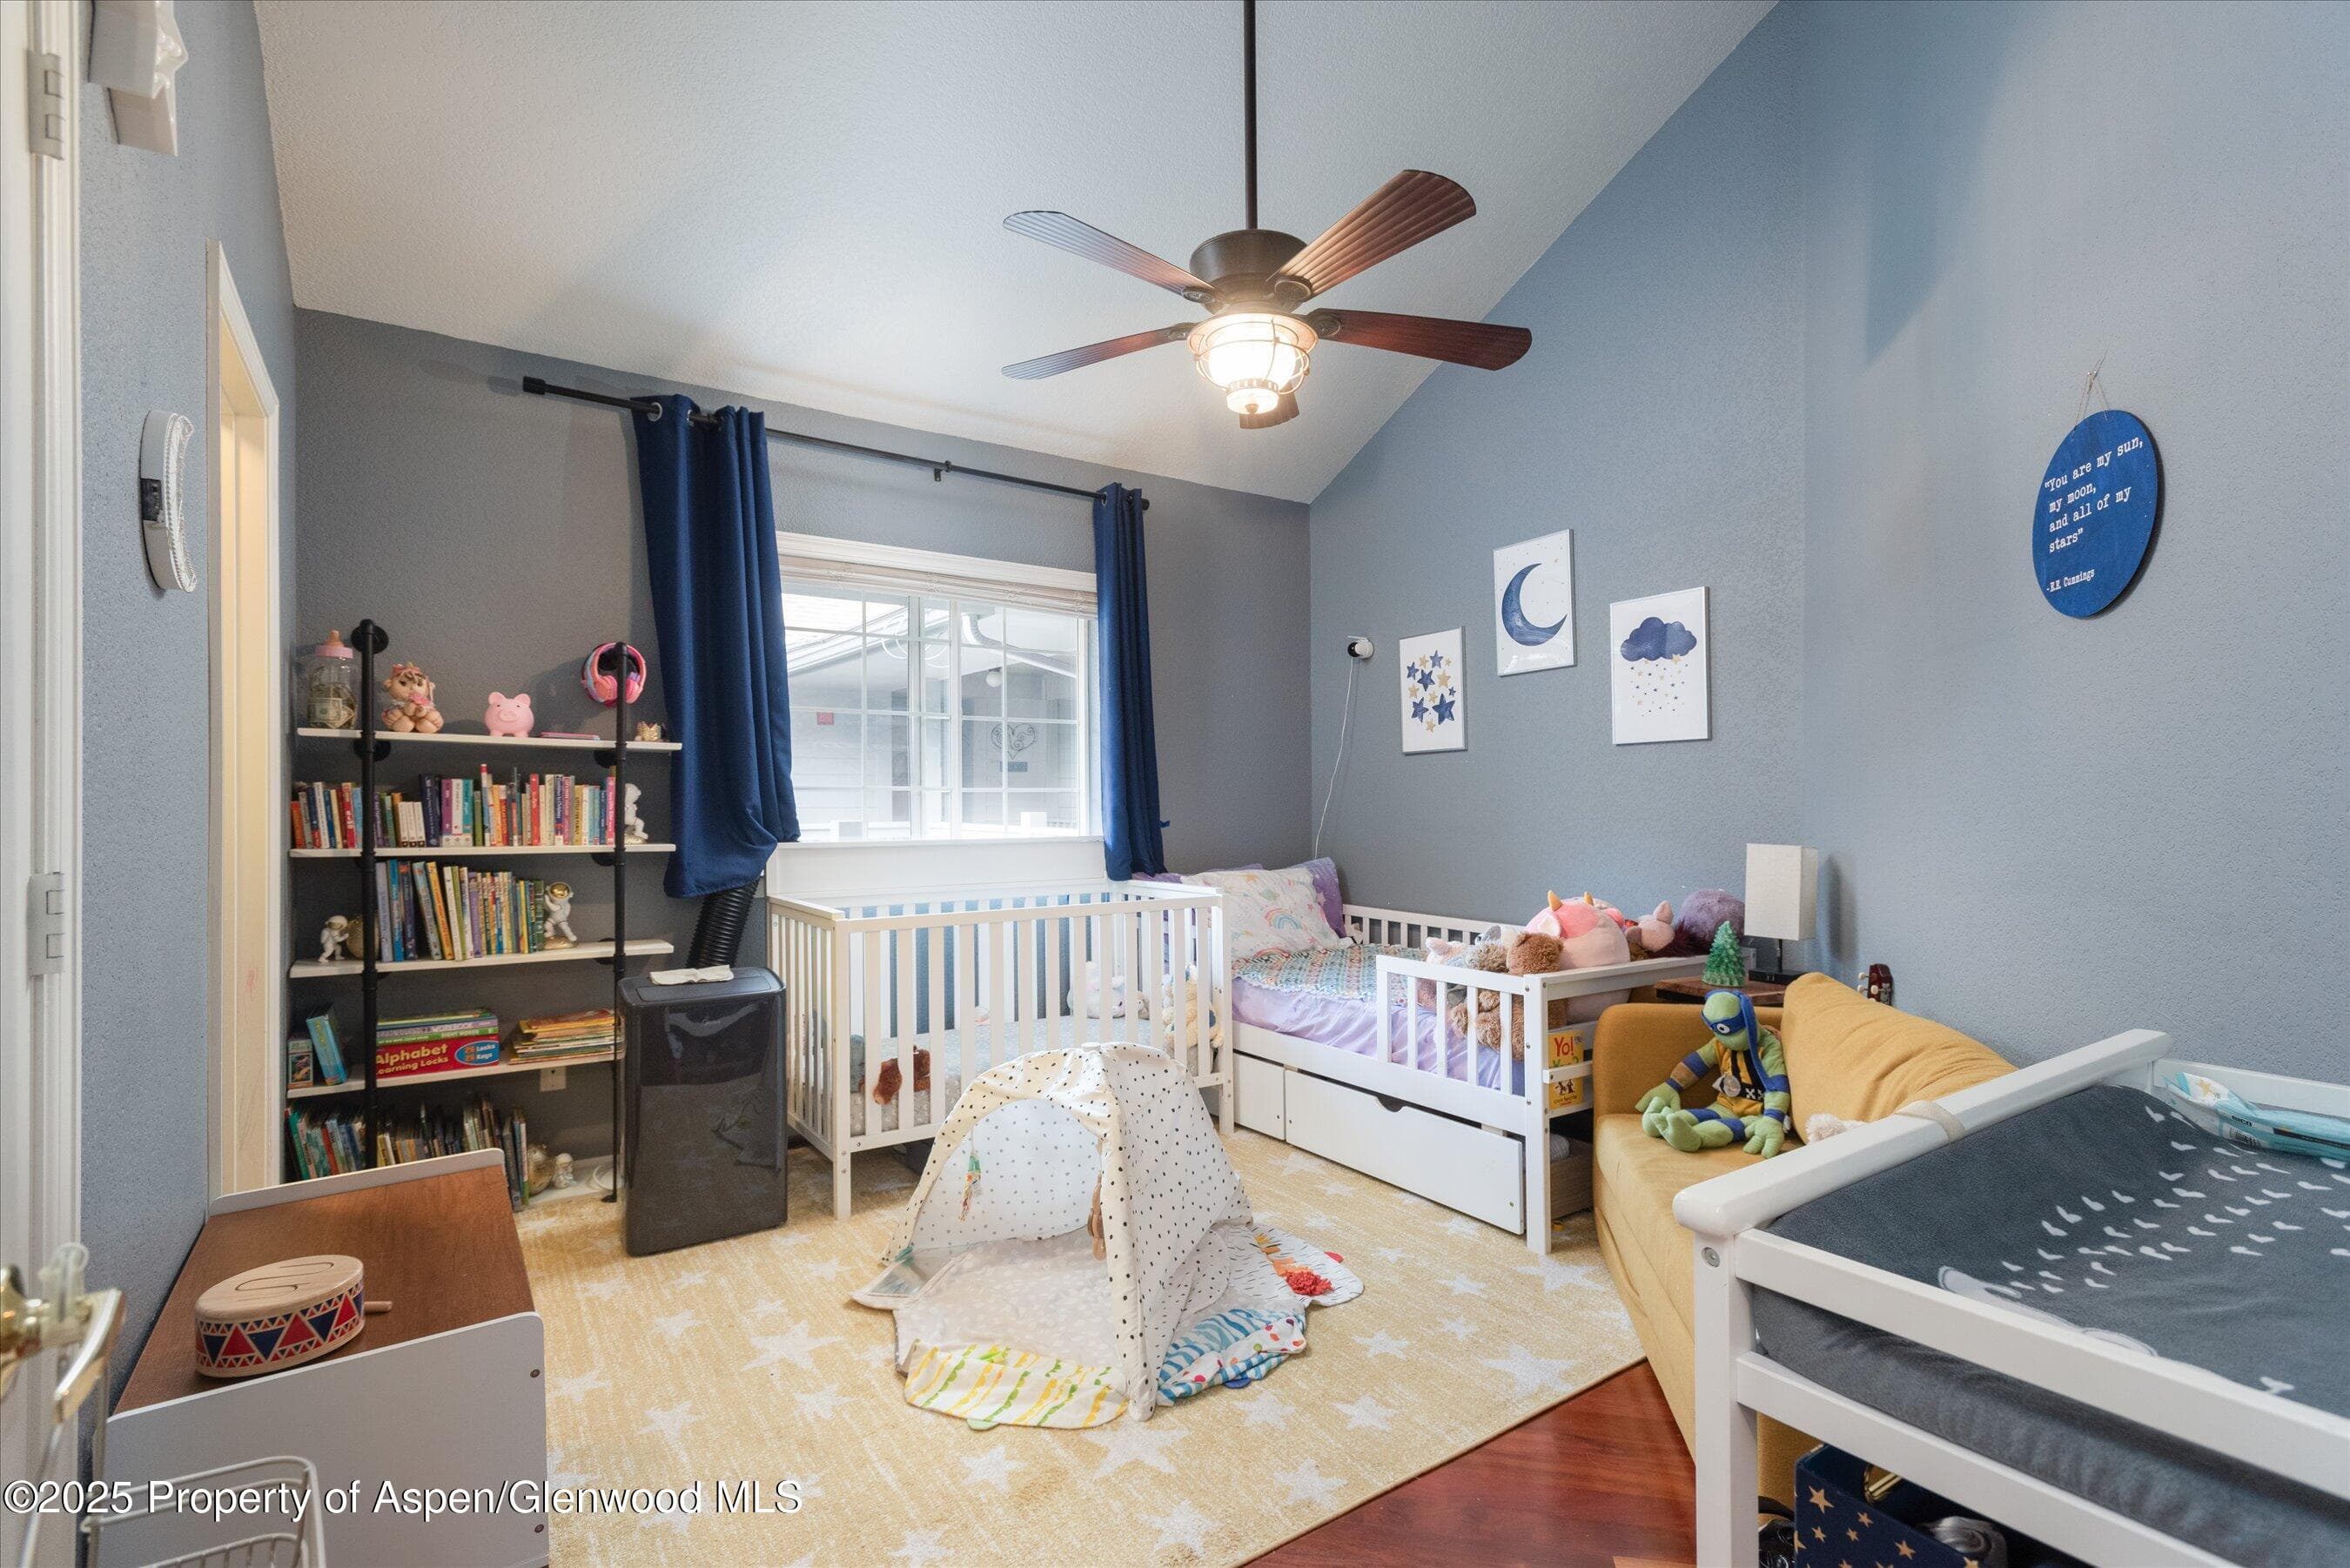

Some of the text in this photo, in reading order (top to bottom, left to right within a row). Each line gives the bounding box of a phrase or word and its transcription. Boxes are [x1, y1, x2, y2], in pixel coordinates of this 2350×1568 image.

[2044, 437, 2144, 492] "You are my sun,
[2049, 483, 2097, 513] my moon,
[2049, 486, 2132, 533] and all of my
[2049, 527, 2084, 553] stars"
[2063, 568, 2095, 587] Cummings
[376, 1043, 448, 1066] Alphabet
[1554, 1036, 1574, 1057] Yo!
[376, 1056, 449, 1075] earning Locks
